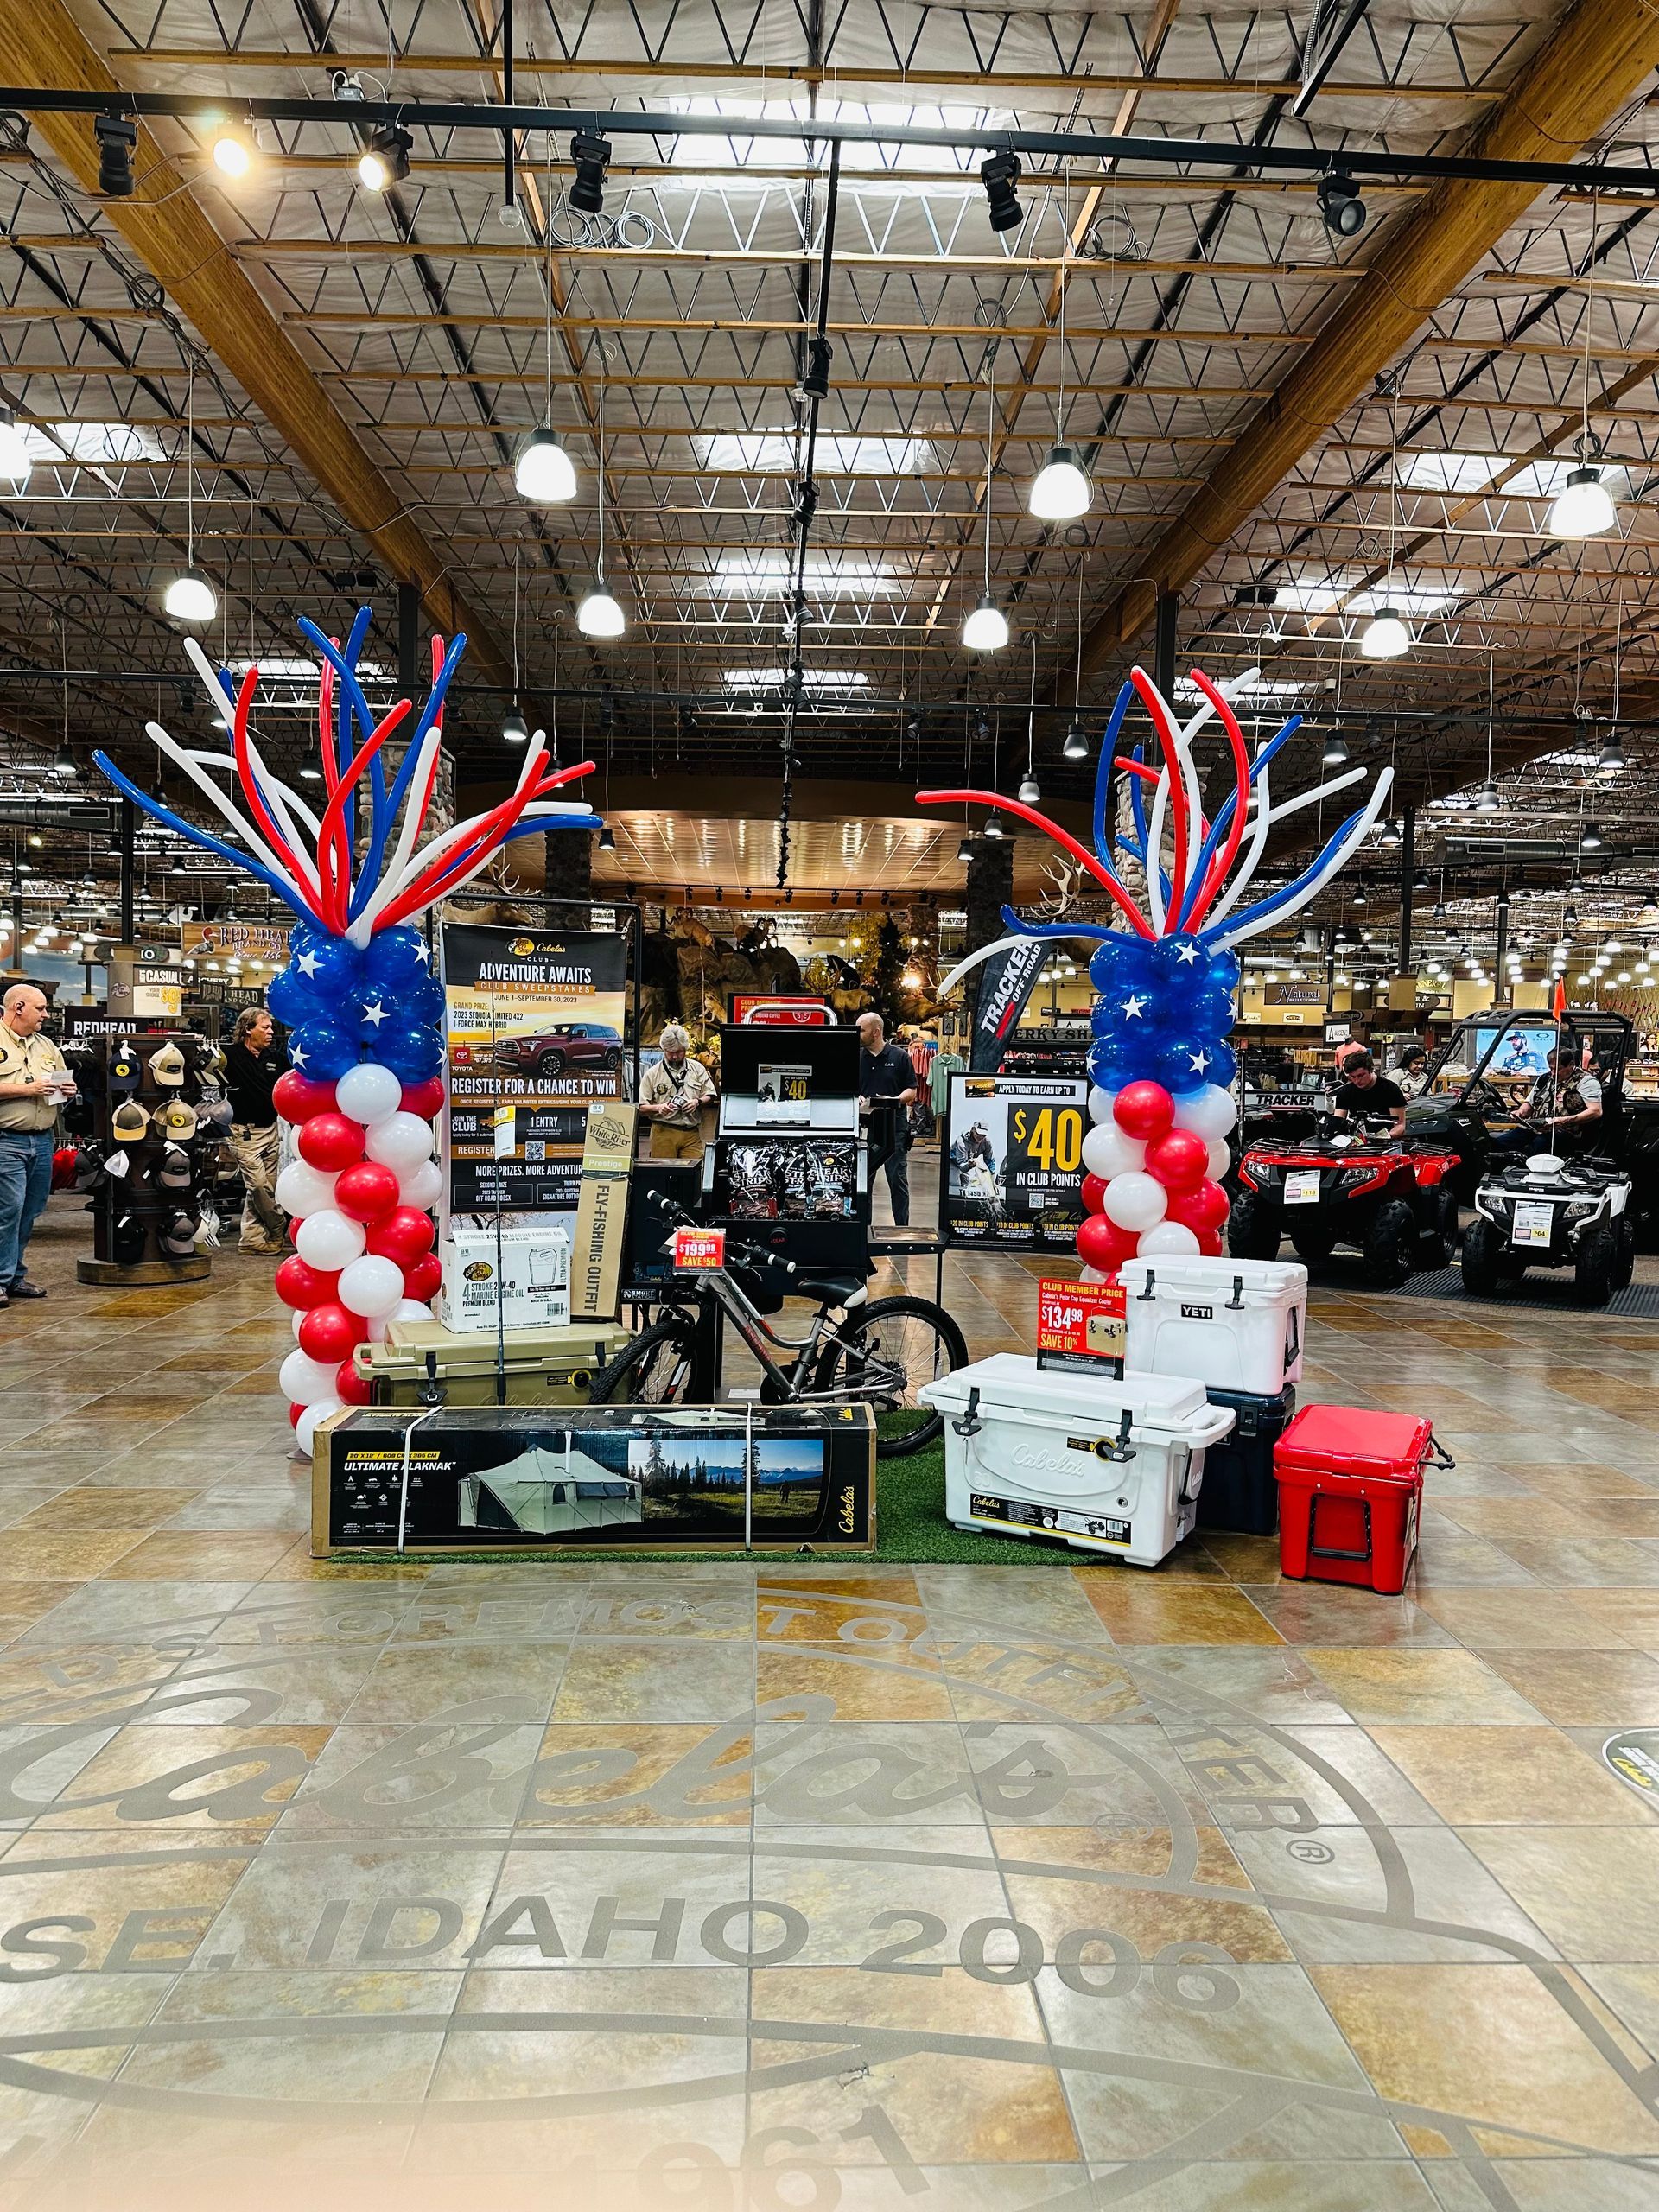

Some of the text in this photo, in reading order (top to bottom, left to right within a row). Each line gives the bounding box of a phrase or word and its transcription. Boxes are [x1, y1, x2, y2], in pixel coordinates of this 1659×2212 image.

[220, 927, 249, 947] RED
[232, 940, 265, 950] BRAND
[537, 942, 566, 953] Cabela's
[234, 950, 257, 959] Since
[479, 963, 592, 984] ADVENTURE AWAITS
[1012, 944, 1042, 1003] OFF ROAD
[480, 982, 590, 994] CLUB SWEEPSTAKES
[980, 941, 1034, 1034] TRACKER
[232, 989, 258, 1002] HEAD
[1274, 985, 1320, 1004] Natural
[454, 1001, 473, 1010] GRAND
[513, 1013, 524, 1021] 4X2
[1014, 1028, 1060, 1040] ERKY
[452, 1078, 616, 1095] REGISTER FOR A CHANCE TO WIN
[785, 1079, 807, 1100] $40
[999, 1084, 1014, 1094] APPLY
[1015, 1084, 1032, 1094] TODAY
[1033, 1085, 1040, 1094] TO
[1040, 1085, 1054, 1095] EARN
[1055, 1086, 1063, 1095] UP
[1063, 1086, 1071, 1095] TO
[1255, 1094, 1315, 1107] TRACKER
[452, 1122, 477, 1132] CLUB
[531, 1116, 558, 1128] 1 ENTRY
[581, 1117, 586, 1127] 5
[589, 1124, 630, 1147] White River
[1014, 1109, 1083, 1172] $40
[458, 1146, 494, 1154] REGISTER
[476, 1164, 582, 1176] MORE PRIZES. MORE ADVENTUR
[589, 1159, 623, 1169] Prestige
[1016, 1172, 1081, 1187] IN CLUB POINTS
[584, 1185, 609, 1312] FLY-FISHING OUTFIT
[683, 1256, 716, 1267] SAVE $50
[462, 1281, 516, 1300] 4 STROKE 2W-40
[471, 1290, 493, 1300] MARINE
[494, 1288, 514, 1299] EGINE
[515, 1288, 524, 1298] OIL
[1042, 1281, 1123, 1298] CLUB MEMBER PRICE
[1182, 1306, 1211, 1318] YETI
[1040, 1333, 1078, 1350] SAVE 10%
[344, 1461, 399, 1471] ULTIMATE
[1010, 1443, 1086, 1478] Cabela's
[972, 1495, 1001, 1509] Cabela's
[836, 1484, 856, 1534] Cabela's
[258, 1597, 817, 1648] FOREMOST
[304, 1895, 810, 1968] IDAHO
[858, 1908, 1242, 2013] 2006
